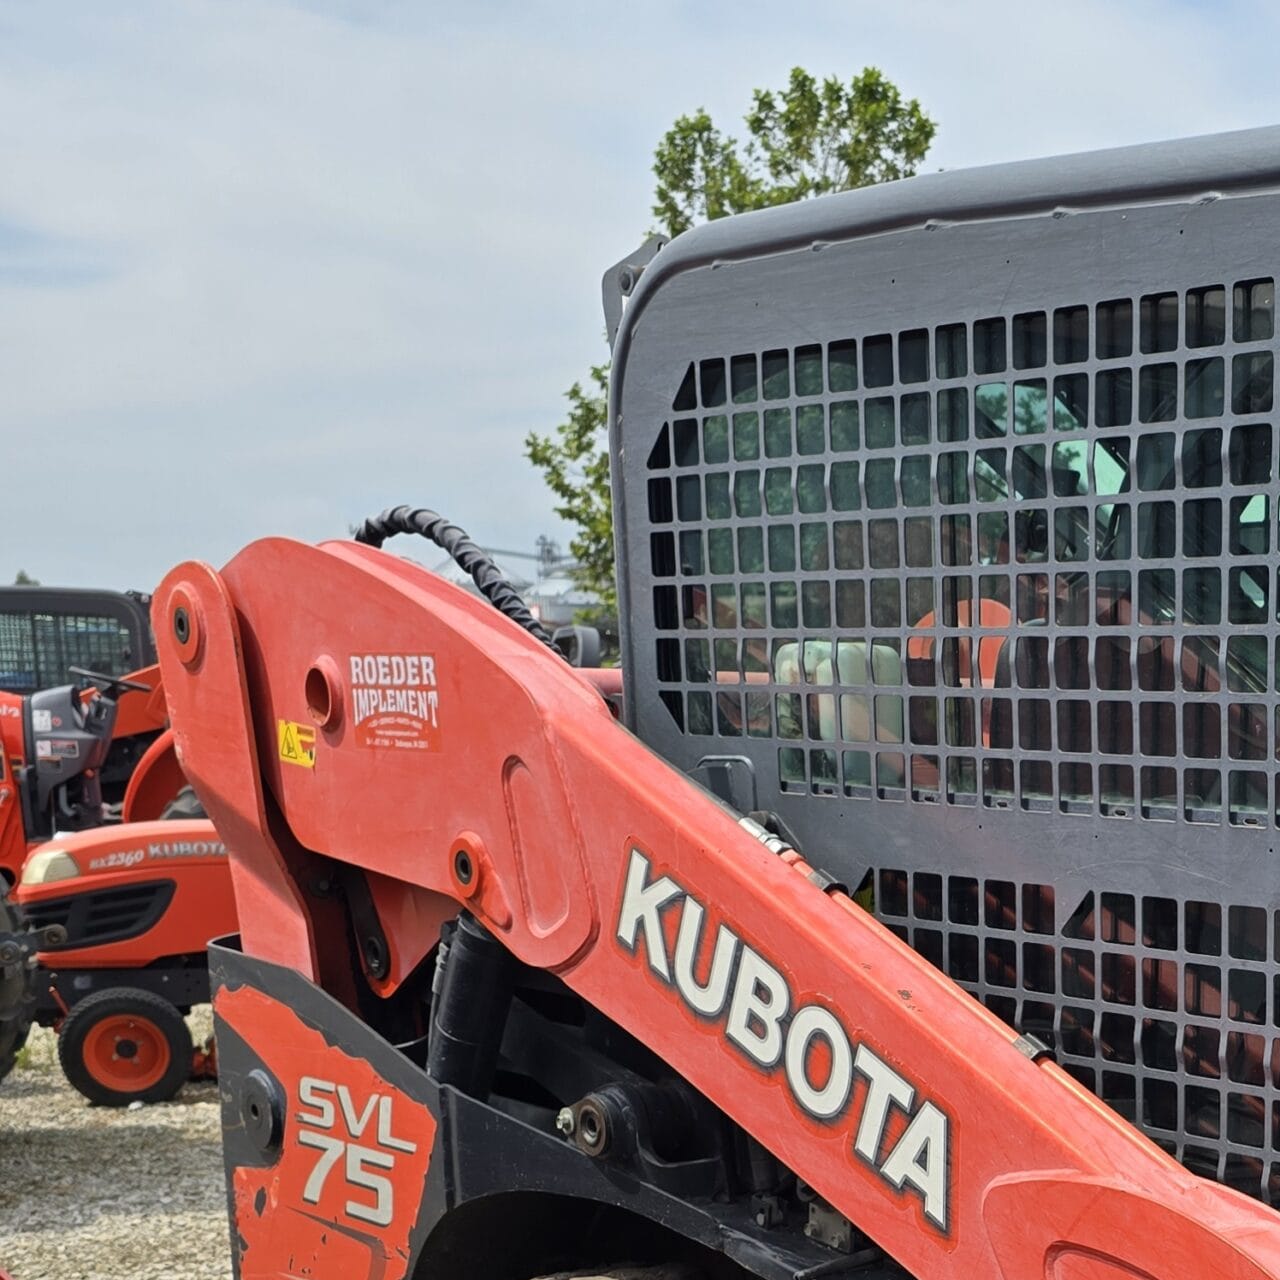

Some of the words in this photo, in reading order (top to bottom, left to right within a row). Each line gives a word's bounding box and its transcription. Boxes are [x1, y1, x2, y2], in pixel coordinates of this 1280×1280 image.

[350, 655, 437, 686] ROEDER
[352, 688, 439, 728] IMPLEMENT
[616, 847, 951, 1234] KUBOTA
[297, 1076, 417, 1154] SVL
[298, 1130, 395, 1228] 75
